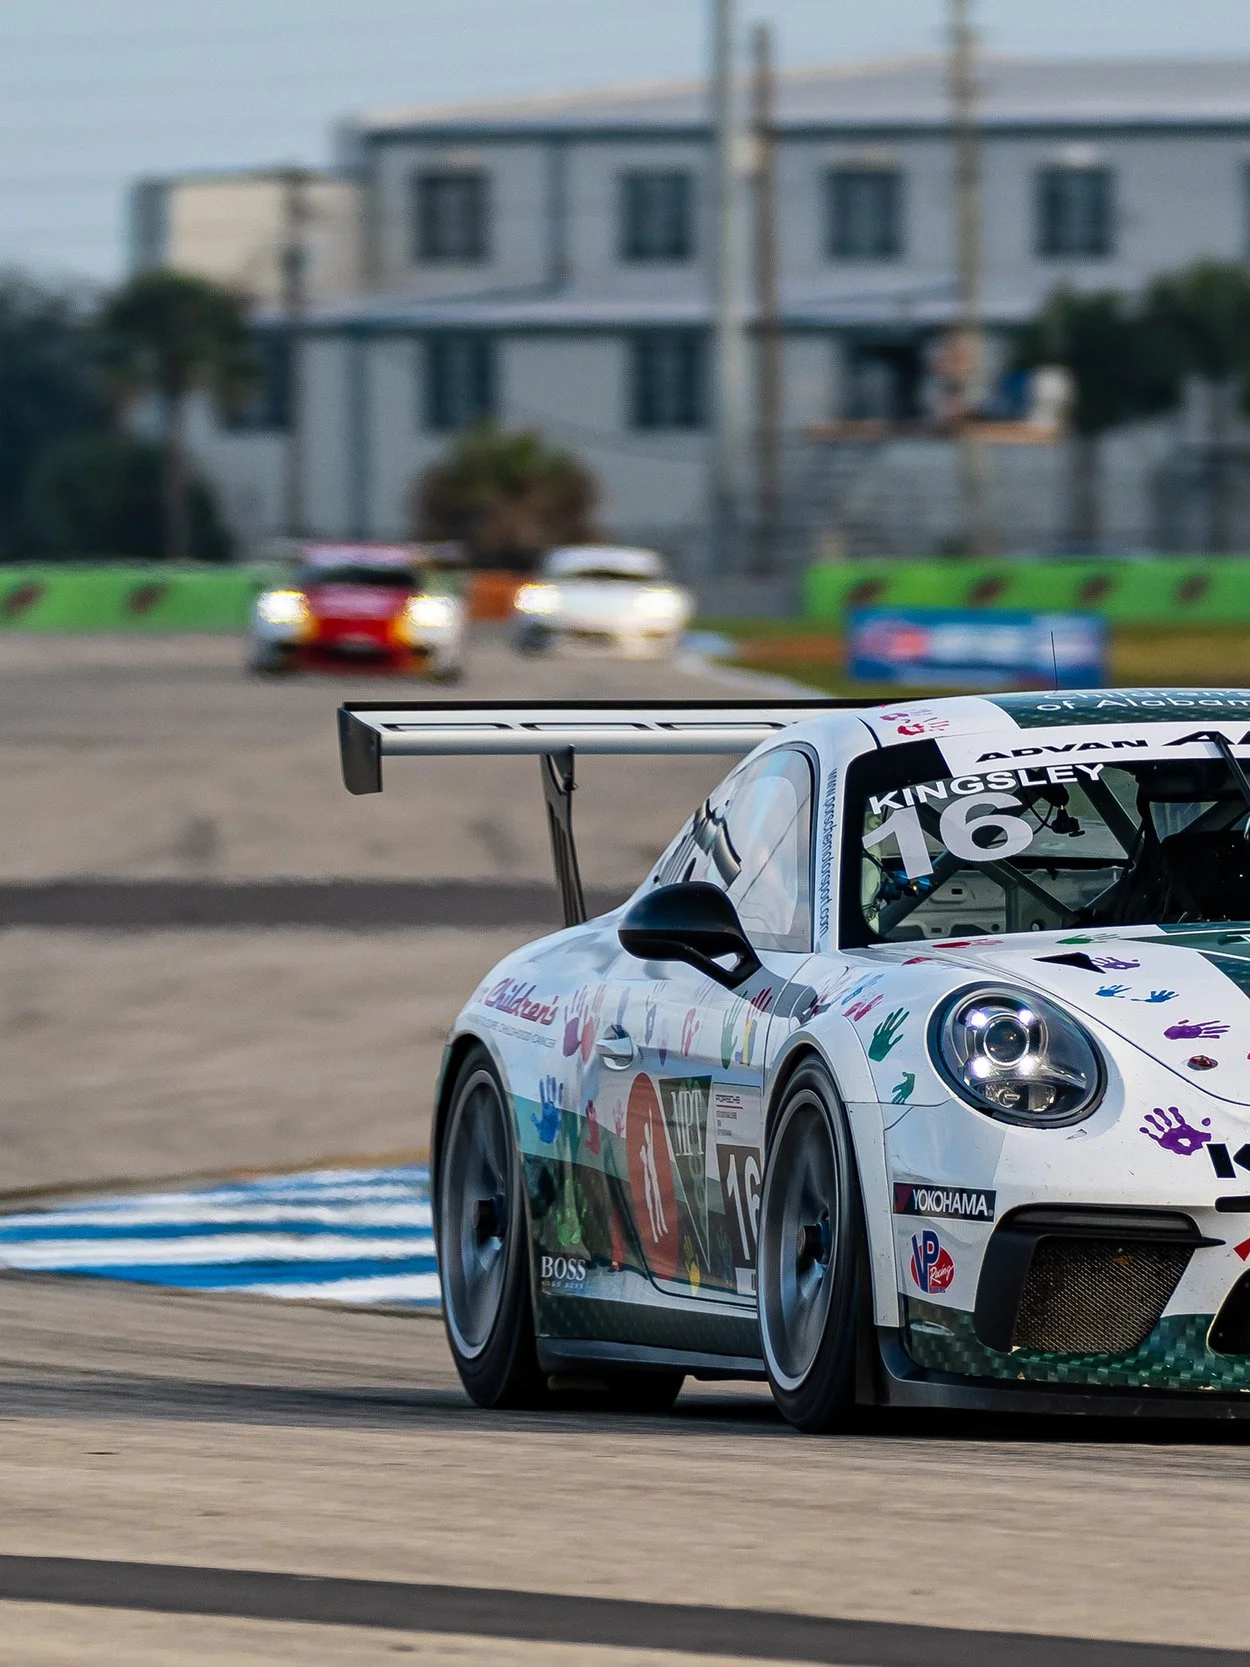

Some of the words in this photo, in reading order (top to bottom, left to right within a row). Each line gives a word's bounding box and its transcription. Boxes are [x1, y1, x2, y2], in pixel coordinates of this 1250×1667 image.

[1036, 700, 1076, 711] of
[975, 739, 1149, 763] ADVAN
[868, 763, 1105, 815] KINGSLEY
[862, 791, 1034, 879] 16
[726, 1153, 761, 1261] 16
[912, 1188, 989, 1217] YOKOHAMA
[540, 1255, 587, 1281] BOSS
